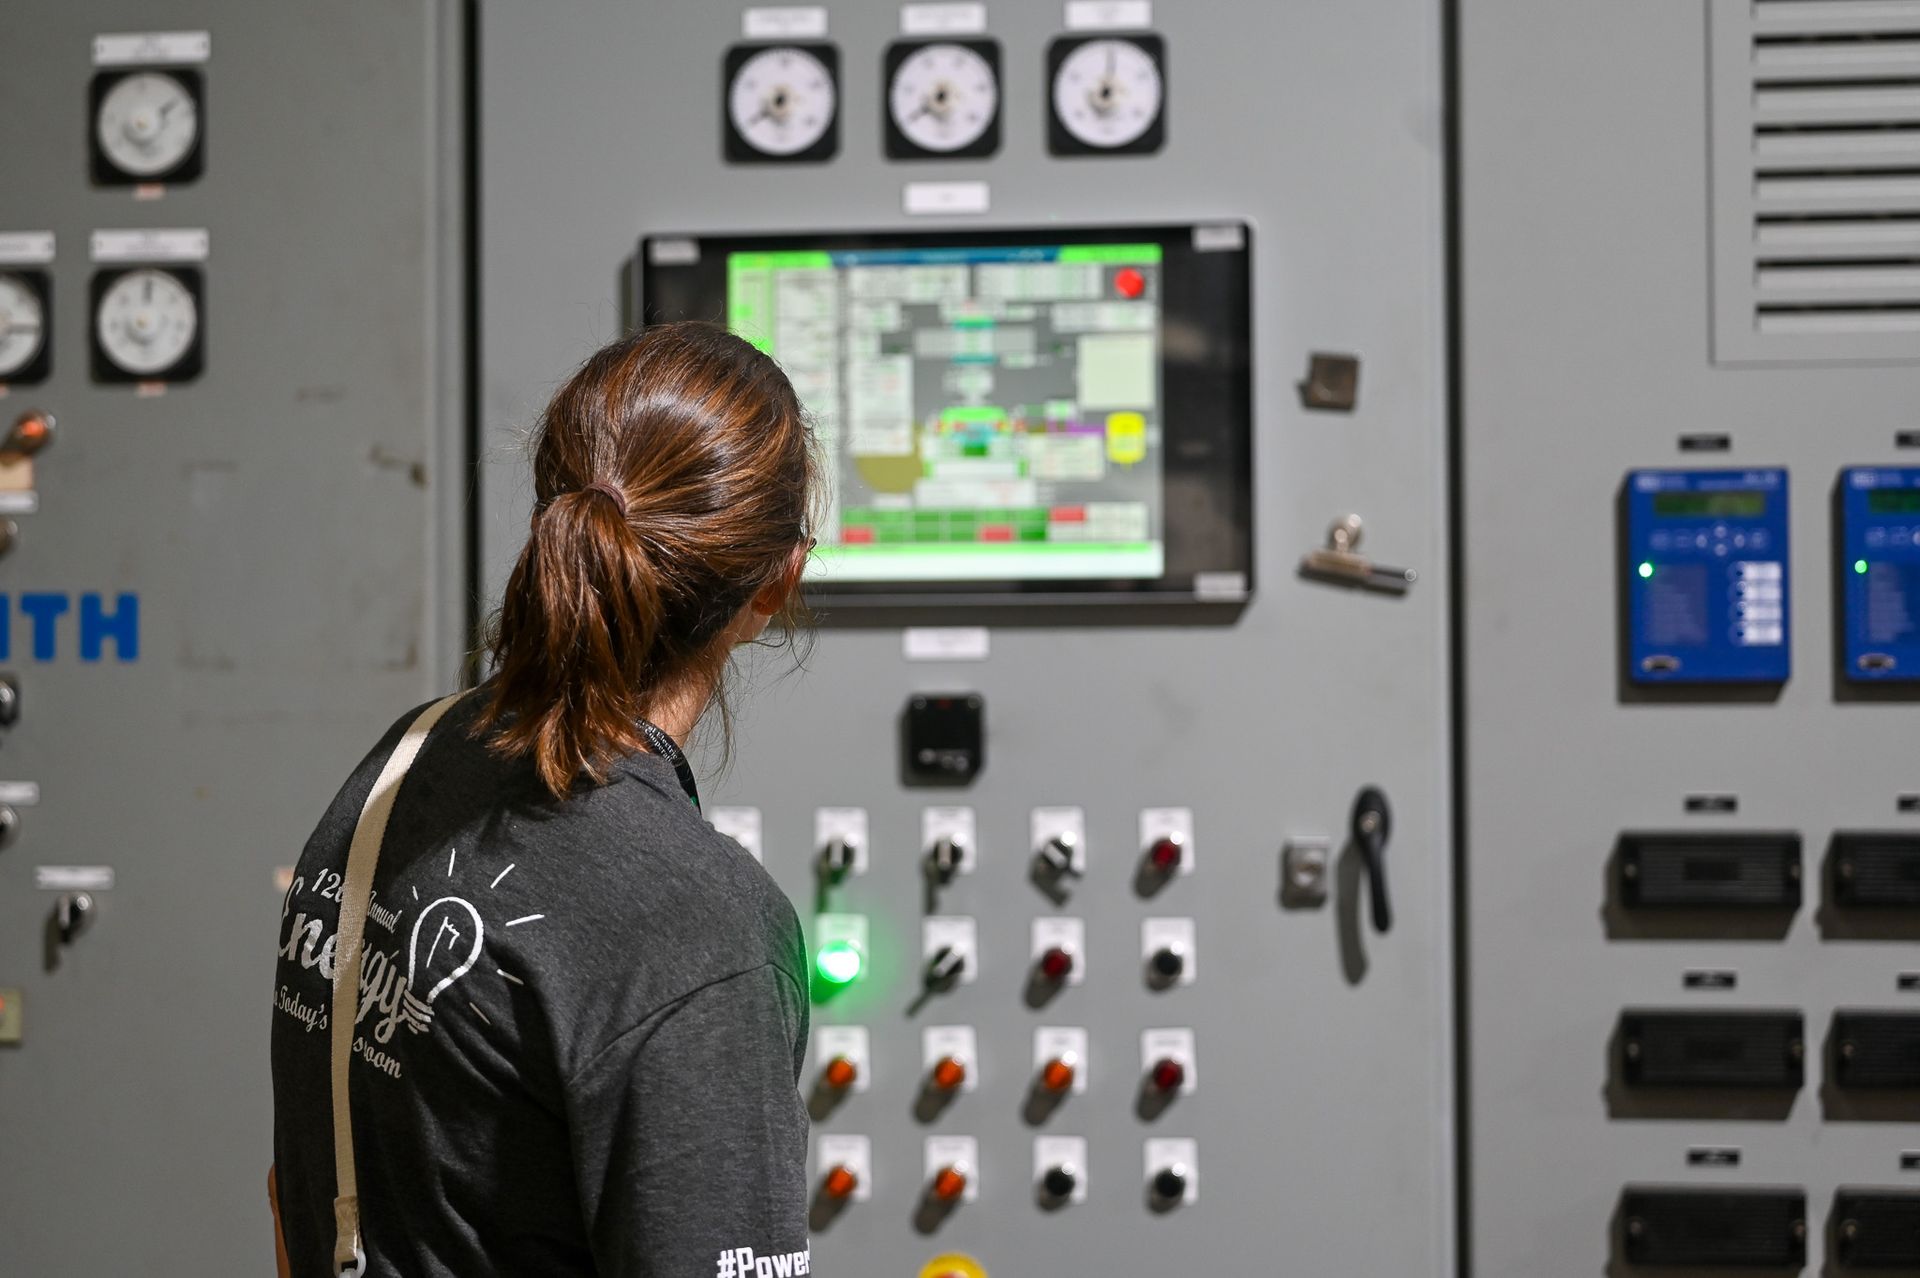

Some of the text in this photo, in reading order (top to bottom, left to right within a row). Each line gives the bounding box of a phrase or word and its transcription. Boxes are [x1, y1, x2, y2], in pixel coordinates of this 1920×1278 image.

[312, 868, 343, 903] 12
[279, 985, 328, 1032] Today's
[352, 1036, 402, 1078] sroom
[717, 1240, 810, 1278] #Power
